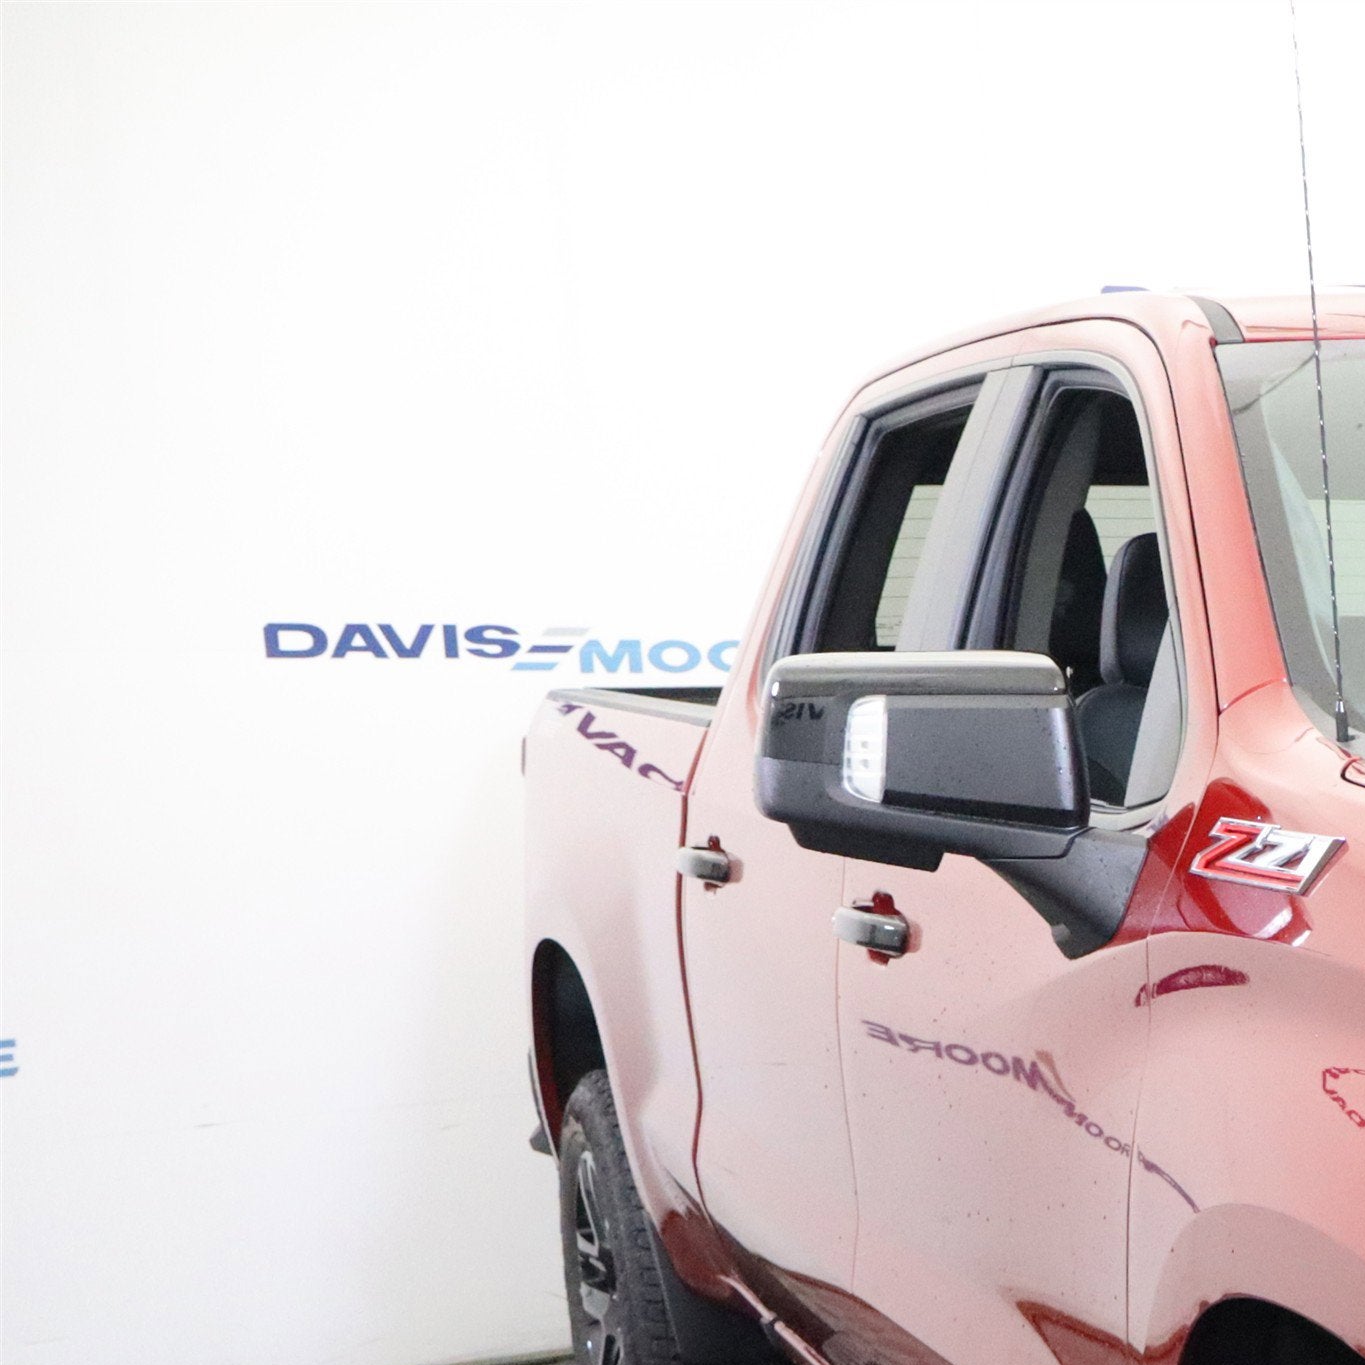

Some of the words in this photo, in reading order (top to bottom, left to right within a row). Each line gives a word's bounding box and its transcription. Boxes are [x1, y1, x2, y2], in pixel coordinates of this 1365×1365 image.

[263, 622, 521, 659] DAVIS
[579, 638, 741, 674] MOO
[1189, 815, 1347, 893] Z71
